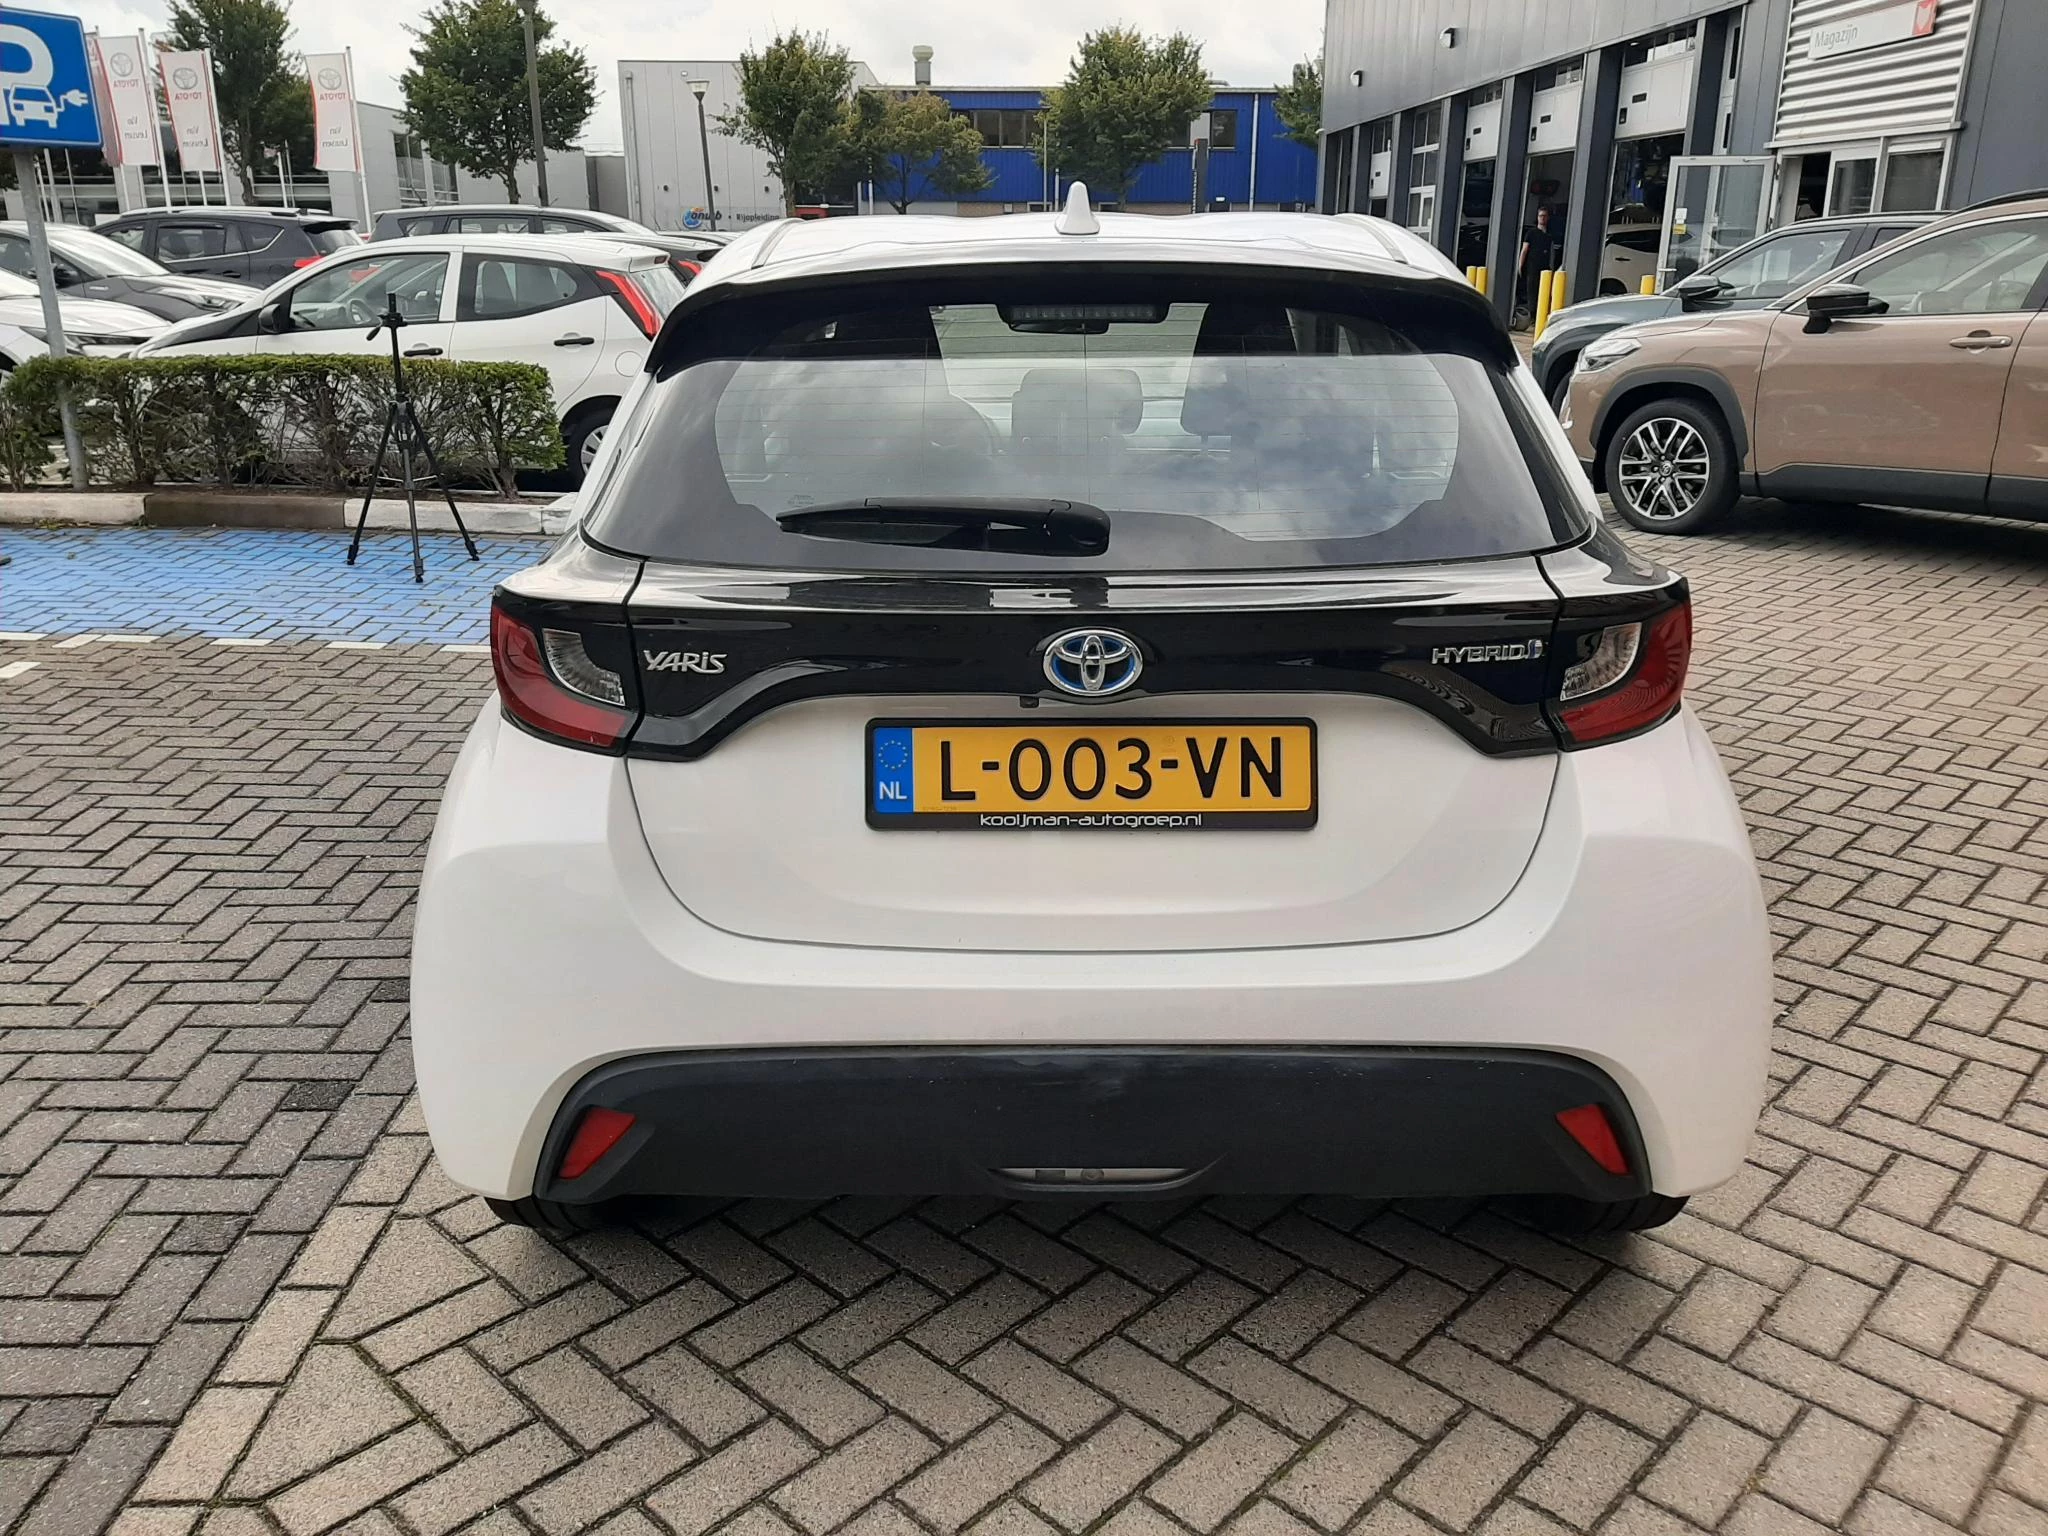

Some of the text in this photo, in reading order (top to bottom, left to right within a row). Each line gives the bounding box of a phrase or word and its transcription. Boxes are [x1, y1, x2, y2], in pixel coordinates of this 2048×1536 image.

[1814, 24, 1858, 49] Magazijn
[0, 23, 54, 126] P
[1431, 644, 1526, 664] HYBRID
[940, 737, 1282, 801] L-003-VN
[879, 781, 907, 799] NL
